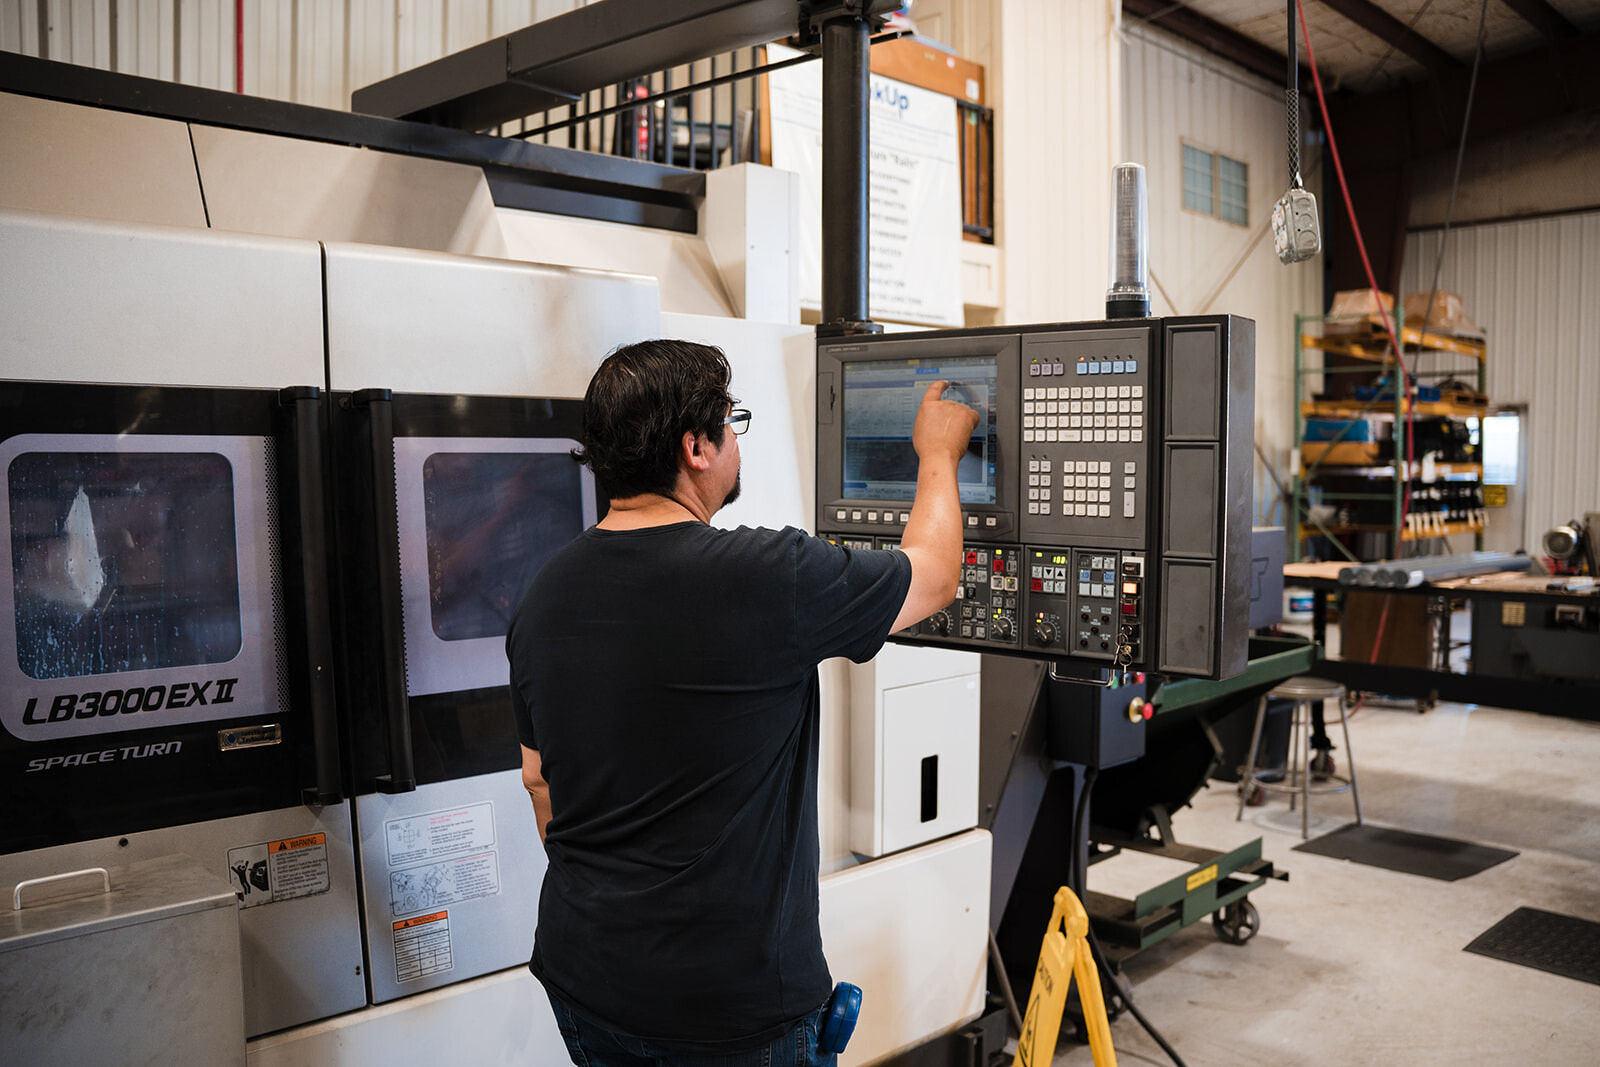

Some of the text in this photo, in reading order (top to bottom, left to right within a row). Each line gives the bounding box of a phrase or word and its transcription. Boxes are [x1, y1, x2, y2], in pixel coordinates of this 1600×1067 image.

[870, 82, 909, 120] kUp
[26, 741, 182, 772] SPACE TURN
[290, 837, 317, 848] WARNING
